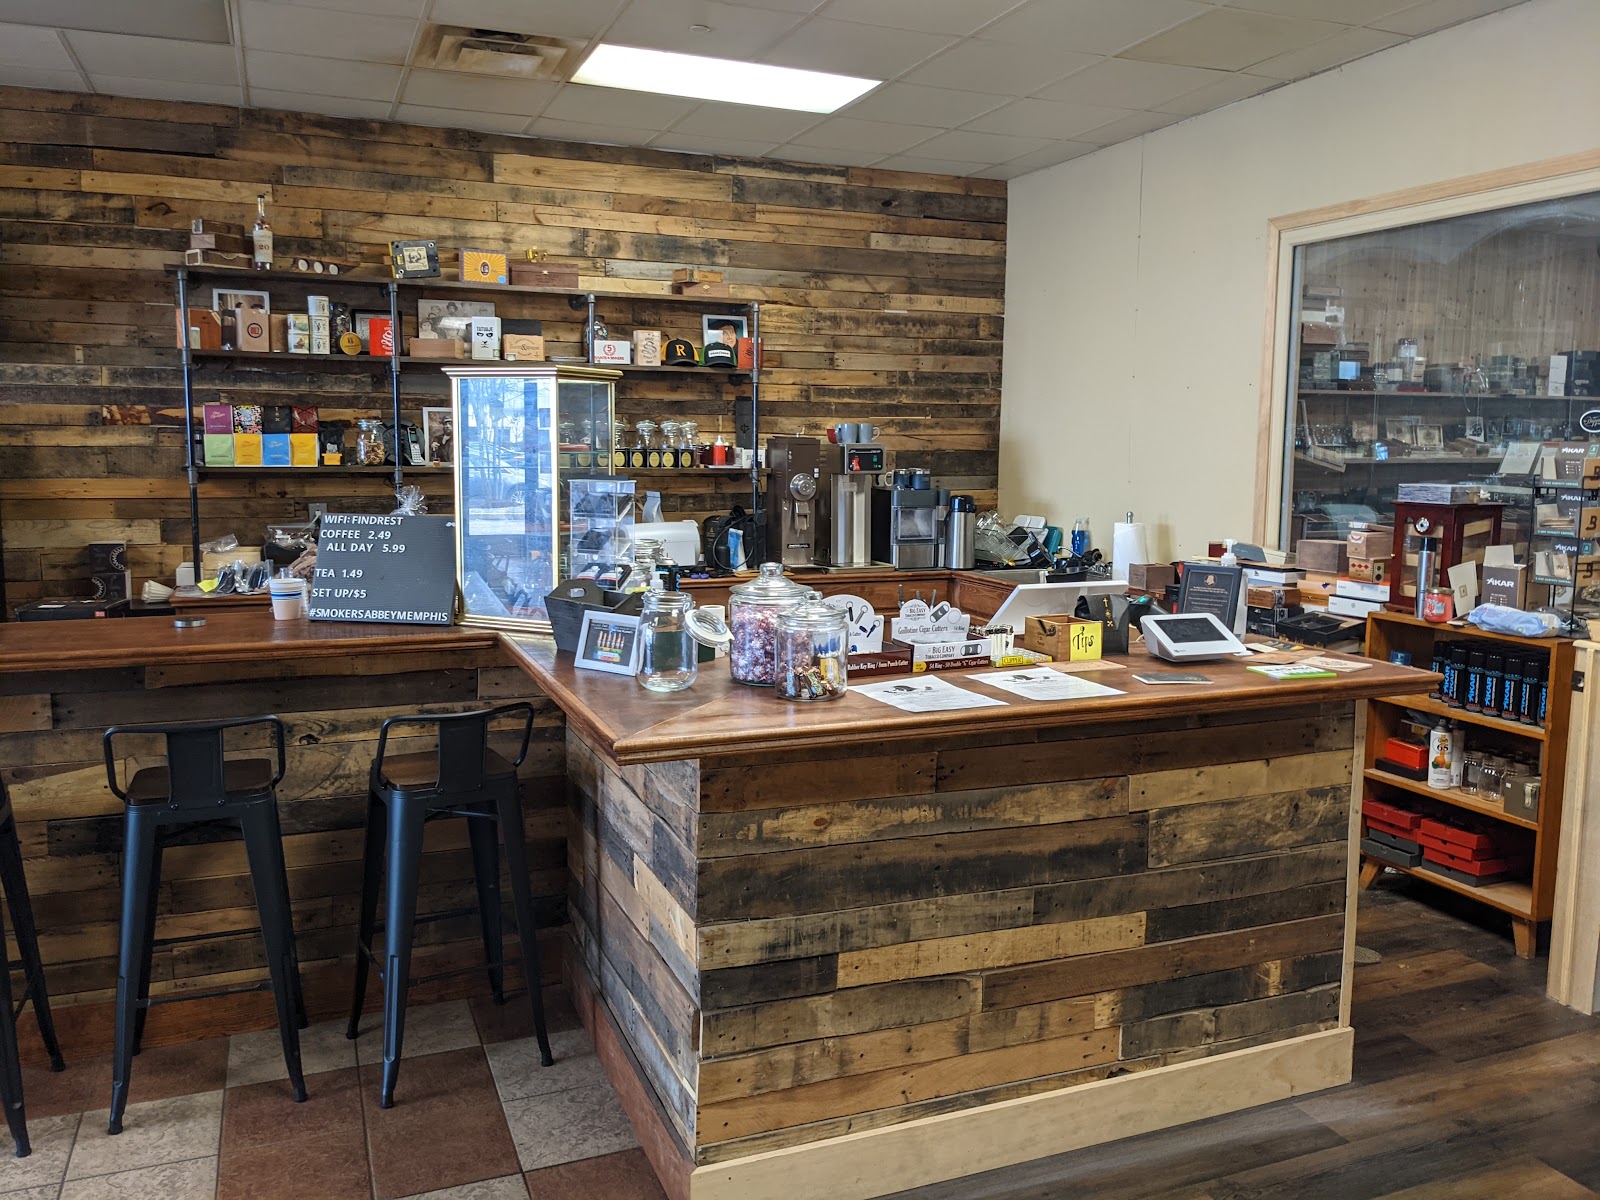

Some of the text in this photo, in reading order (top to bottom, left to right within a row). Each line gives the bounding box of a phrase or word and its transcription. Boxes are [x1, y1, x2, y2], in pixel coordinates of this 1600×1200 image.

[675, 344, 686, 356] R
[324, 515, 403, 525] WIFI: FINDREST
[320, 529, 391, 540] COFFEE 2.49
[326, 543, 406, 553] ALL DAY 5.99
[316, 569, 363, 578] TEA 1.49
[1486, 578, 1514, 588] XIKAR
[312, 588, 367, 599] SET UP/$5
[309, 608, 448, 621] #SMOKERSABBEYMEMPHIS
[919, 625, 930, 633] Cigar
[1072, 626, 1094, 653] Tips
[1468, 673, 1476, 702] XIKAR
